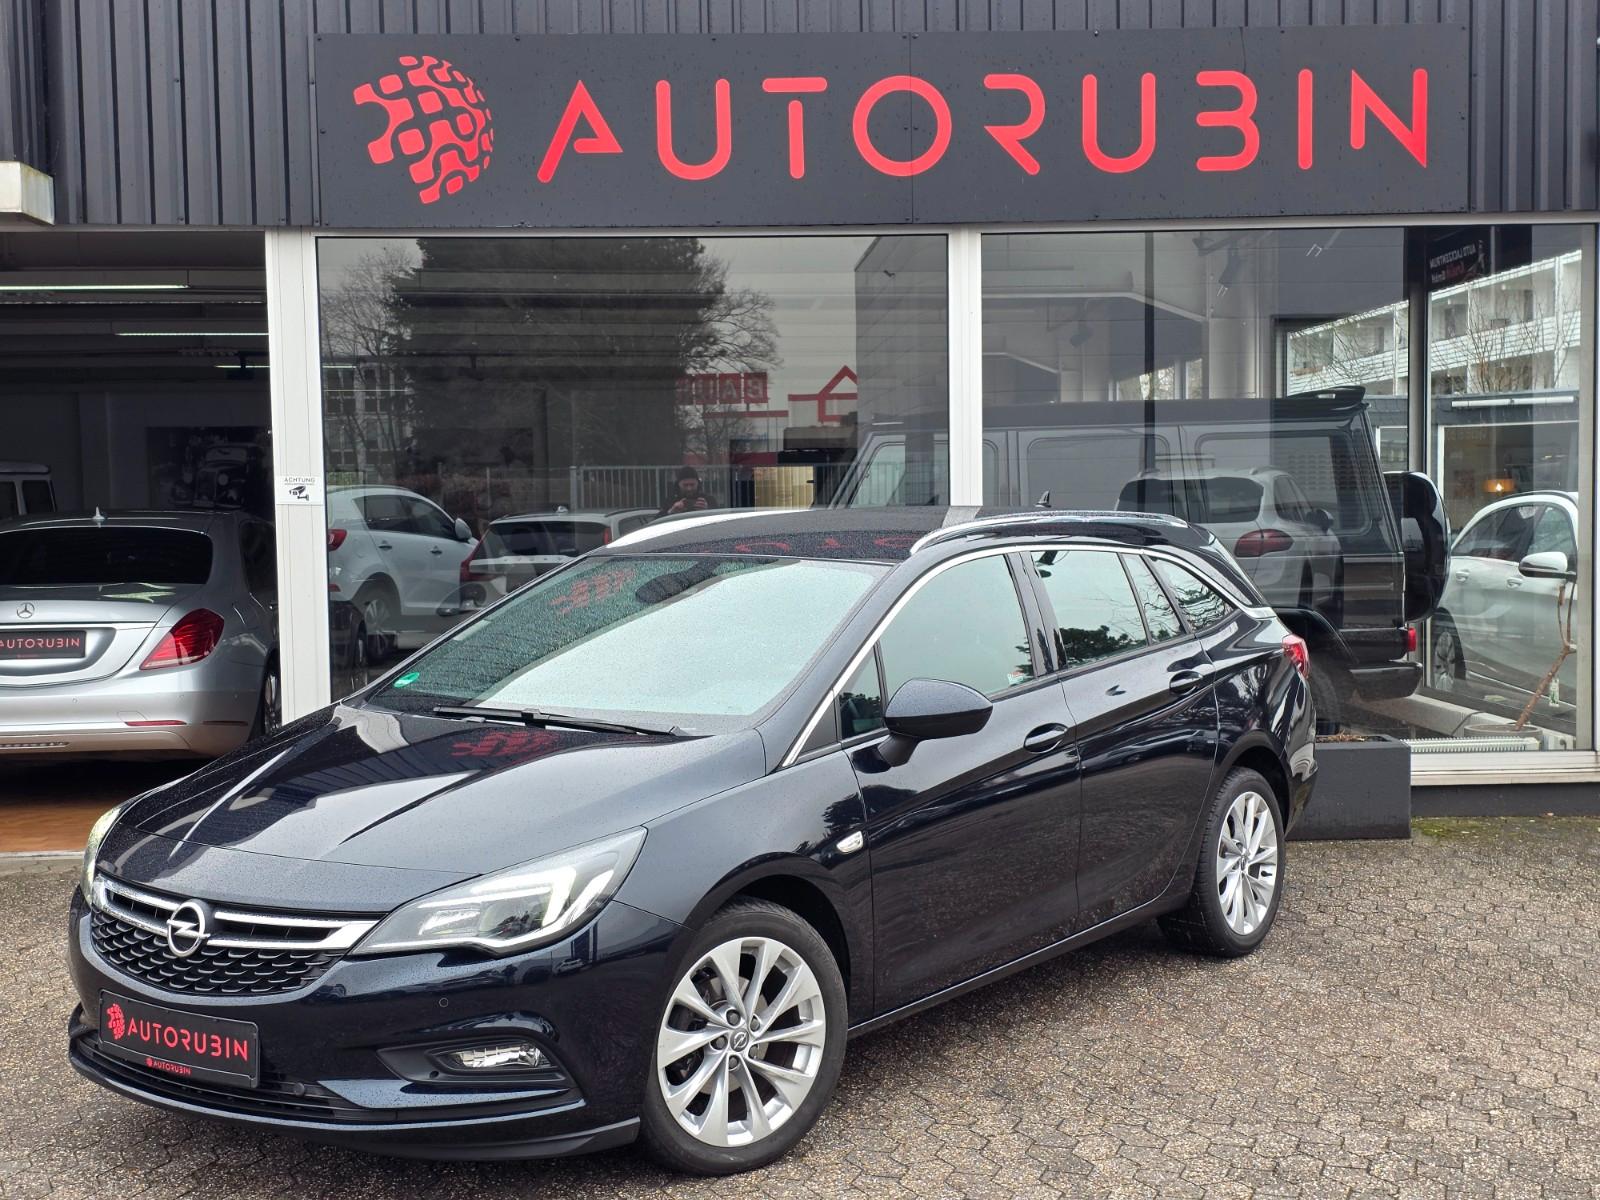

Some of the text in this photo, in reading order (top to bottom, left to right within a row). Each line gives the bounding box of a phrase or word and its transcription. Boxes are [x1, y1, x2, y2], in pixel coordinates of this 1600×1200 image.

[537, 68, 1428, 182] AUTORUBIN
[127, 1017, 248, 1062] AUTORUBIN
[153, 1060, 192, 1076] AUTORUBIN
